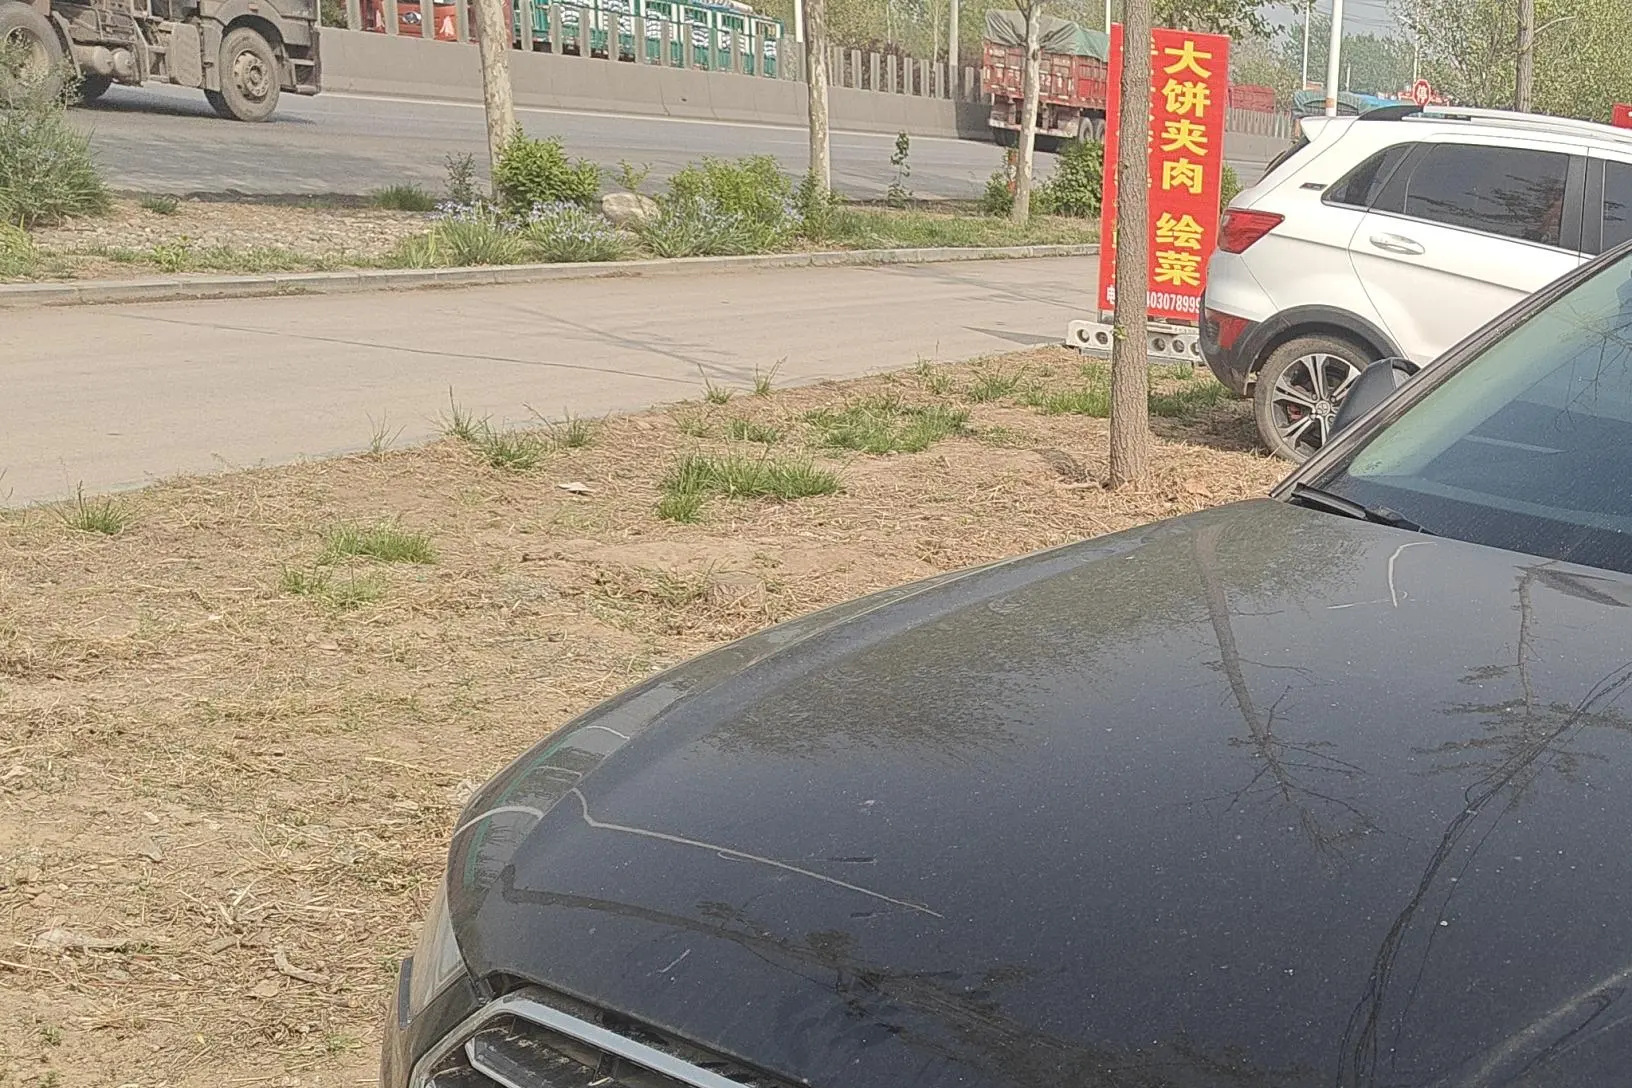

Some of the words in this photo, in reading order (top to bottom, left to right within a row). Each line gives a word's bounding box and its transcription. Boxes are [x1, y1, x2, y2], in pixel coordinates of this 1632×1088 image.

[1160, 40, 1213, 194] 大饼夹肉
[1153, 212, 1205, 287] 绘菜
